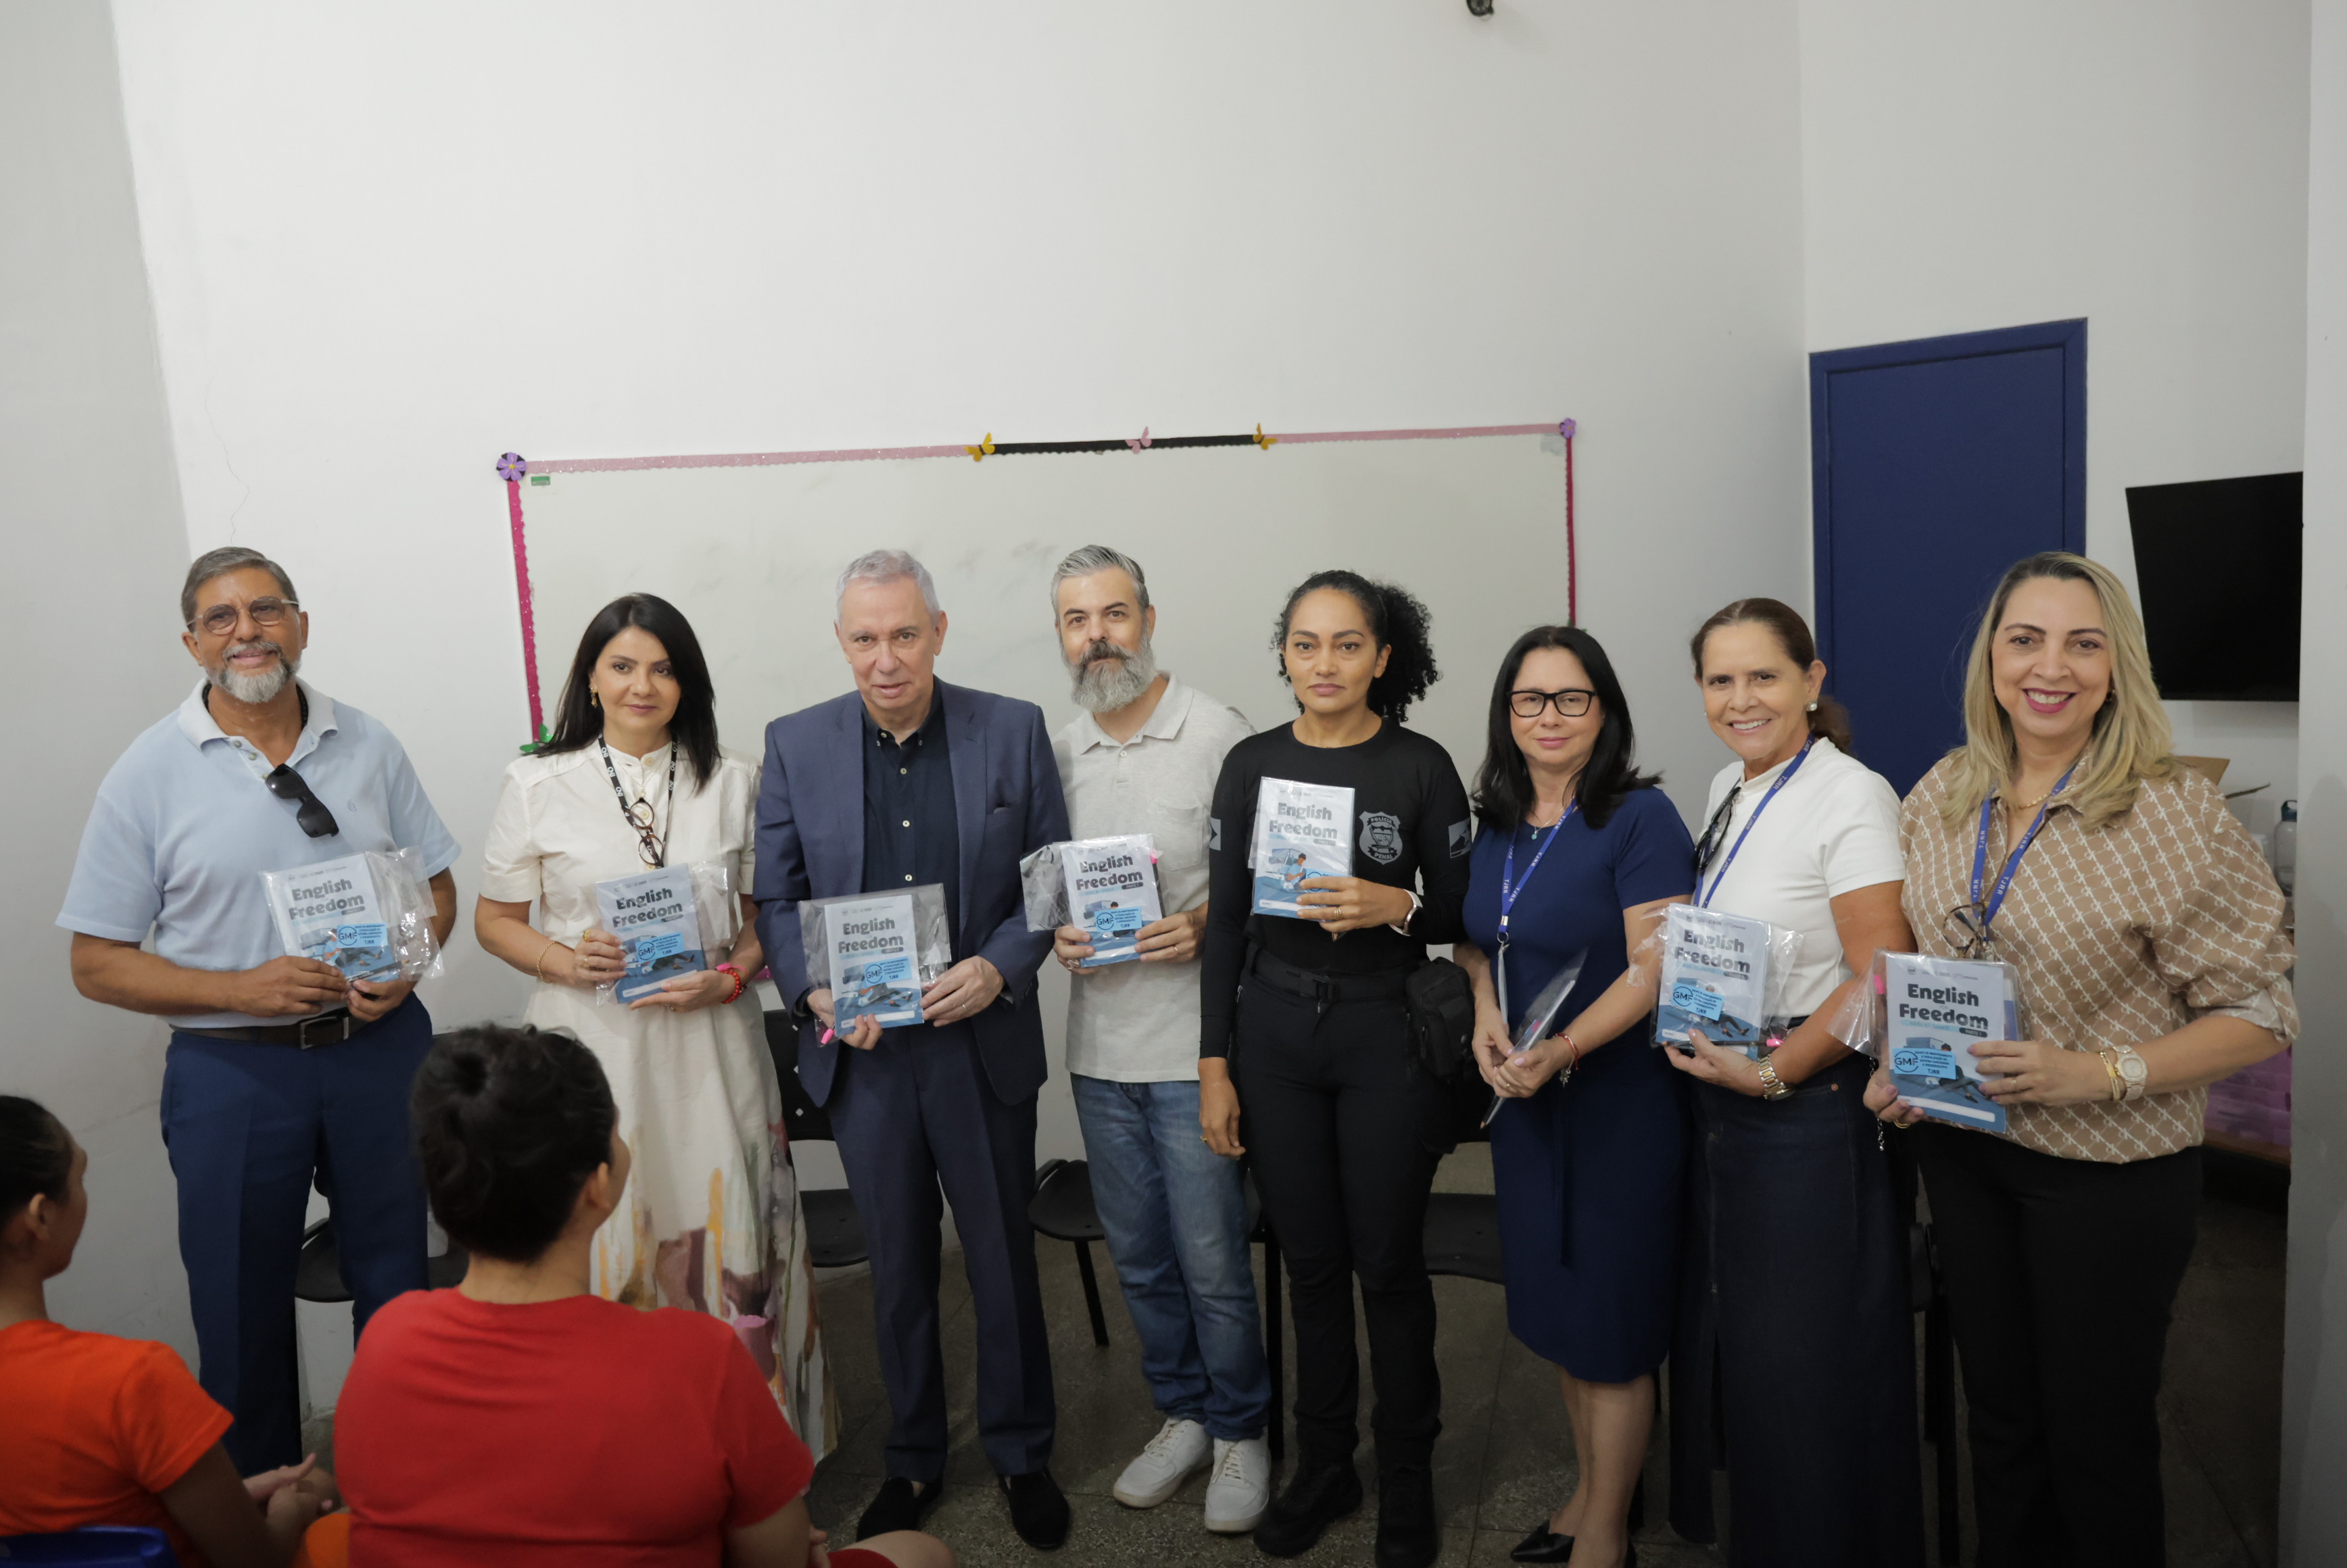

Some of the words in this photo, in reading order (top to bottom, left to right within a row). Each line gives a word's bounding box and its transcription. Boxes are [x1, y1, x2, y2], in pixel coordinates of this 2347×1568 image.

[1773, 775, 1787, 790] TJRR
[1278, 802, 1332, 820] English
[1269, 819, 1338, 839] Freedom
[1555, 815, 1566, 829] TJRR
[1745, 815, 1757, 831] TJRR
[2018, 832, 2031, 850] TJRR
[1080, 855, 1134, 873] English
[1531, 852, 1543, 866] TJRR
[1721, 858, 1731, 873] TJRR
[291, 879, 353, 901] English
[1075, 871, 1143, 891] Freedom
[1997, 876, 2009, 895] TJRR
[616, 887, 673, 910] English
[1509, 887, 1520, 902] TJRR
[289, 895, 364, 920] Freedom
[612, 903, 683, 928] Freedom
[843, 917, 895, 935] English
[1096, 917, 1113, 925] GMF
[338, 932, 357, 940] GMF
[838, 935, 904, 954] Freedom
[1684, 929, 1744, 953] English
[638, 946, 655, 956] GMF
[1674, 946, 1750, 973] Freedom
[865, 969, 882, 979] GMF
[1673, 991, 1693, 1002] GMF
[1908, 983, 1979, 1006] English
[1900, 1003, 1988, 1029] Freedom
[1895, 1057, 1918, 1066] GMF
